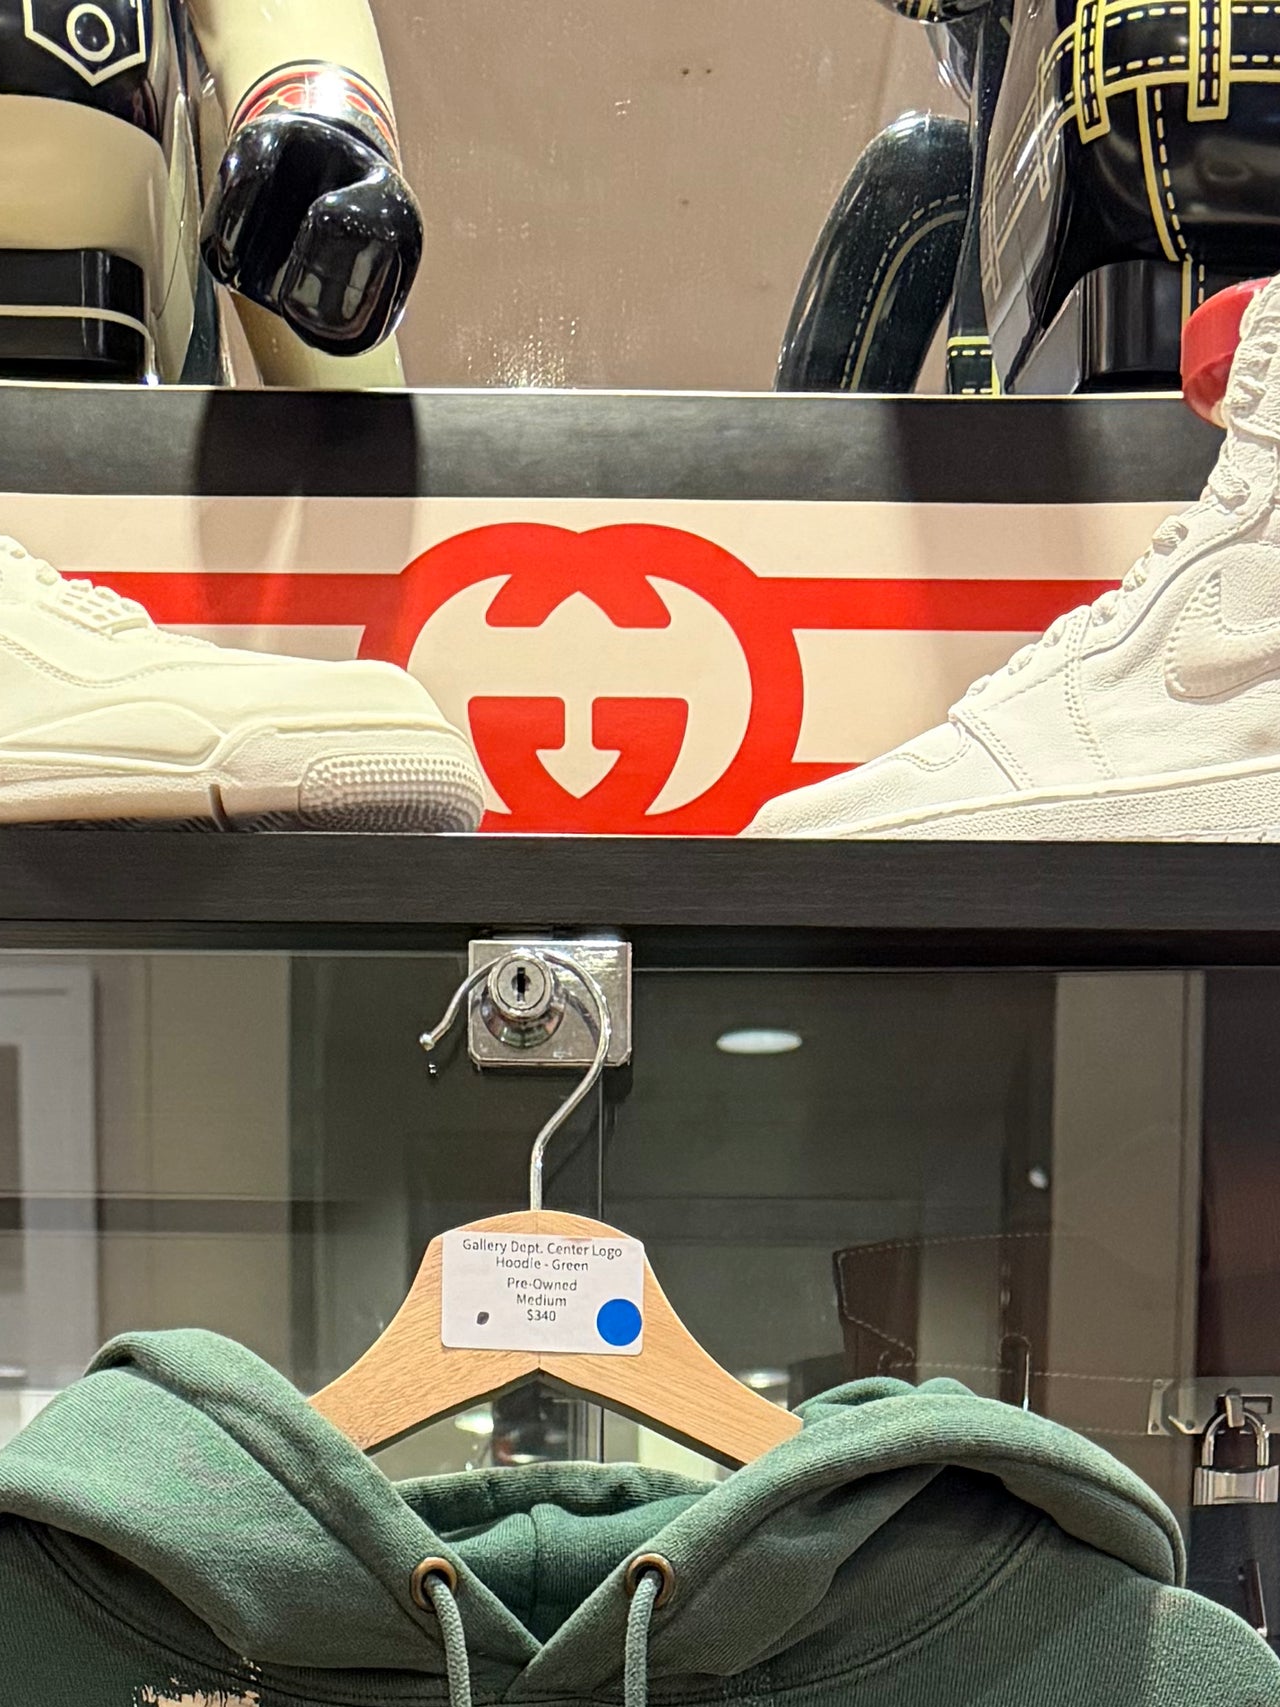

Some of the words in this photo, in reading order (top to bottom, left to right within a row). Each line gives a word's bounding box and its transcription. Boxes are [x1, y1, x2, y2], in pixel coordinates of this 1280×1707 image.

[463, 1239, 507, 1254] Gallery
[511, 1240, 543, 1257] Dept.
[547, 1242, 589, 1257] Center
[591, 1245, 622, 1261] Logo
[496, 1257, 541, 1270] Hoodie
[551, 1259, 589, 1272] Green
[507, 1277, 577, 1292] Pre-Owned
[516, 1294, 567, 1307] Medium
[526, 1309, 556, 1322] $340
